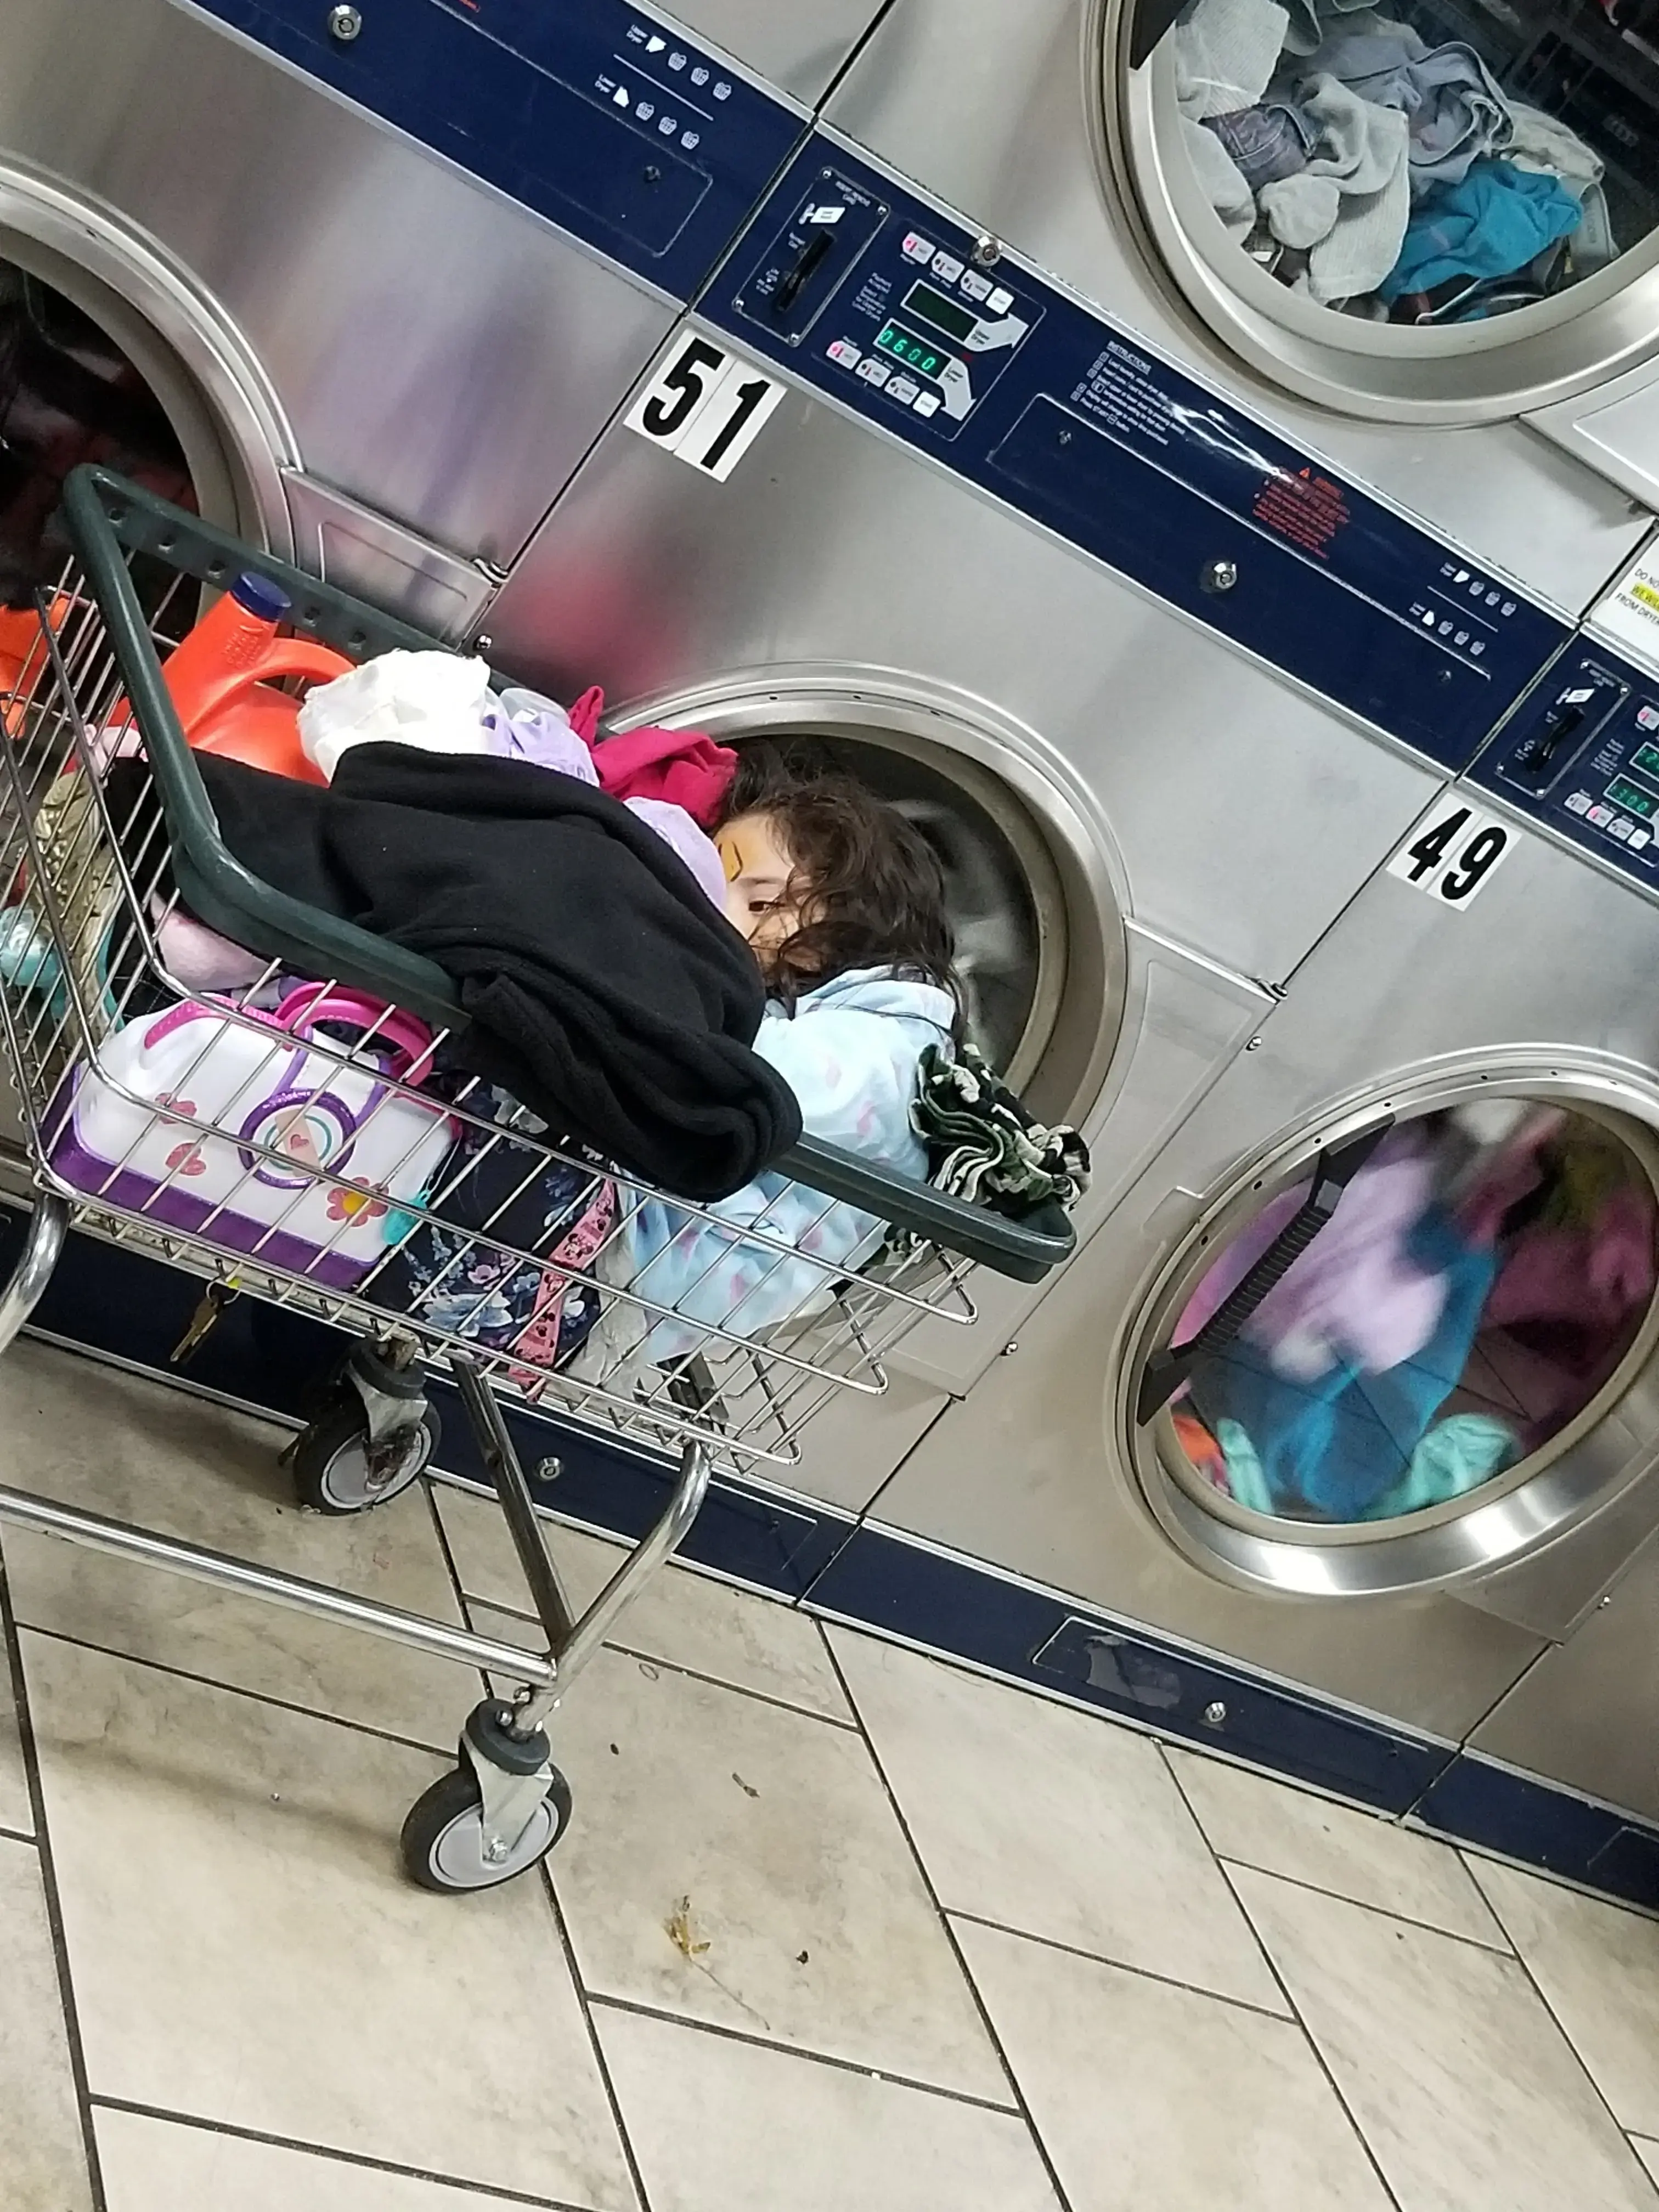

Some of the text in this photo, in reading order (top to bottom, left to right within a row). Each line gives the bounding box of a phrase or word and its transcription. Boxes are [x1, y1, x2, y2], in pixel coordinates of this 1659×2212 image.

[878, 330, 936, 370] 0600
[642, 337, 771, 471] 51
[1635, 568, 1649, 580] DO
[1407, 808, 1507, 900] 49
